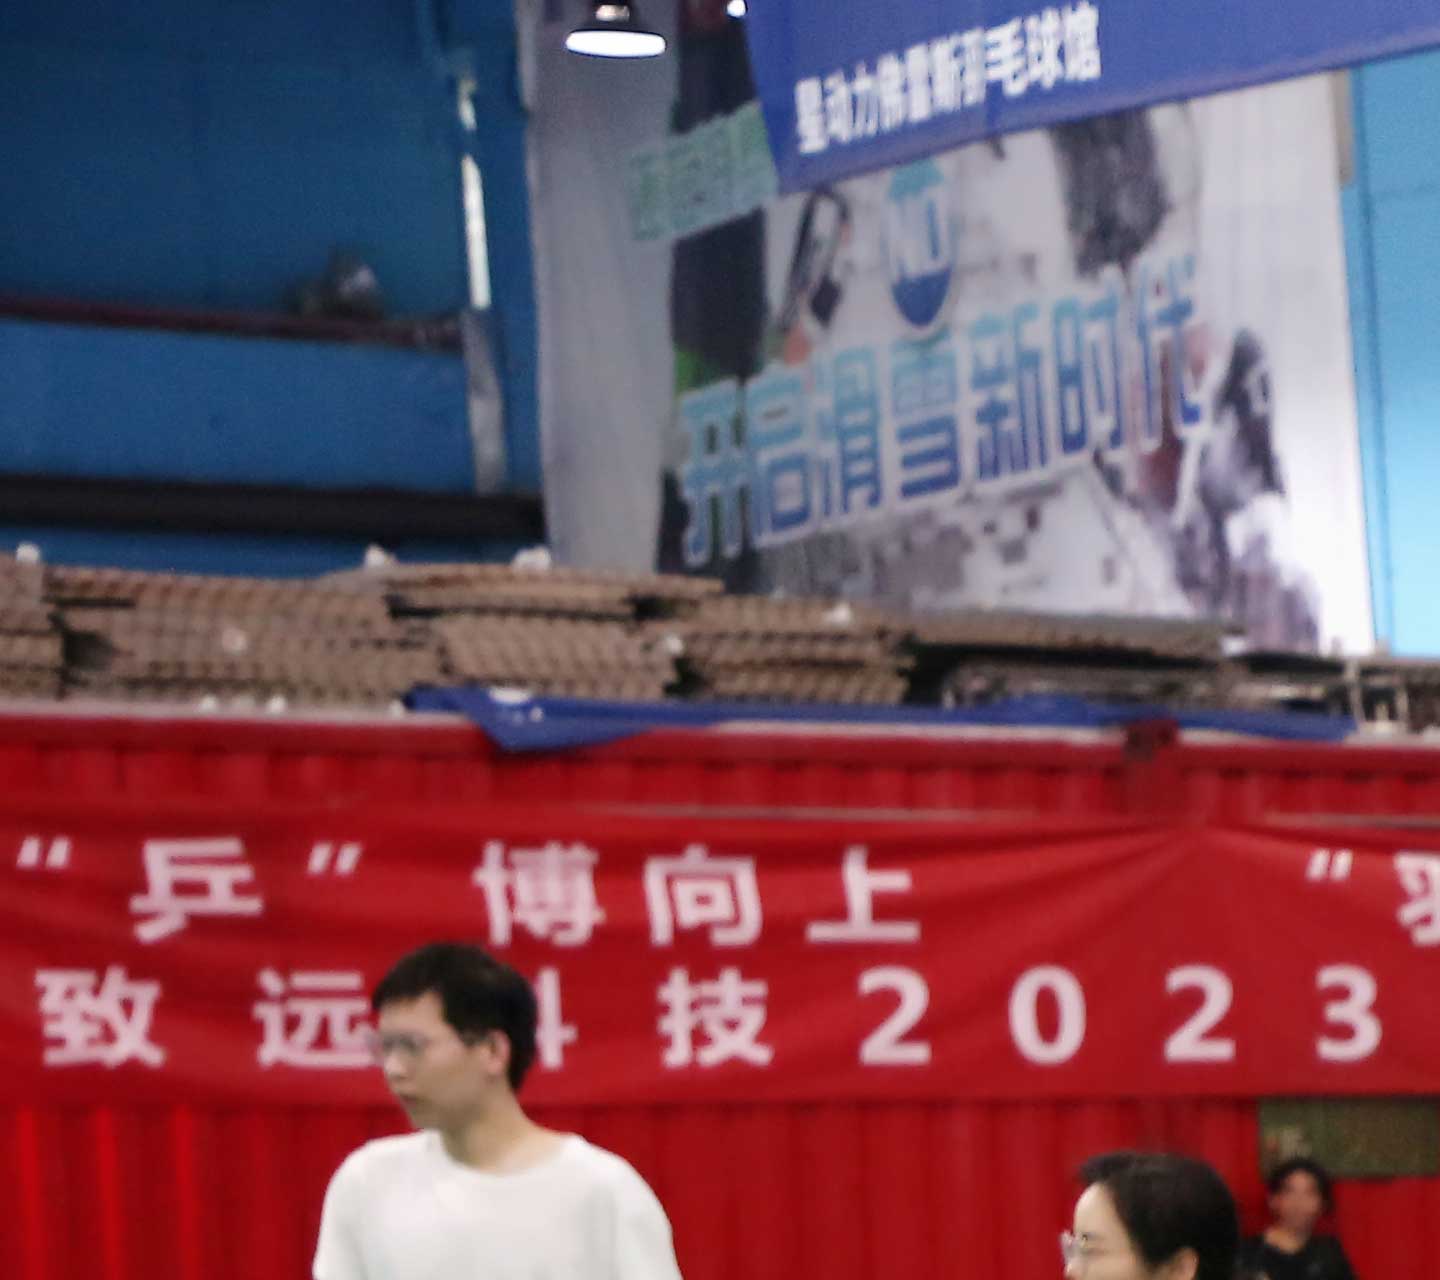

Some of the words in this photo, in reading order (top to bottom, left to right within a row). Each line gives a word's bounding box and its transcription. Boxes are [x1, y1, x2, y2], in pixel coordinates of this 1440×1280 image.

[680, 253, 1204, 562] 开启滑雪新时代
